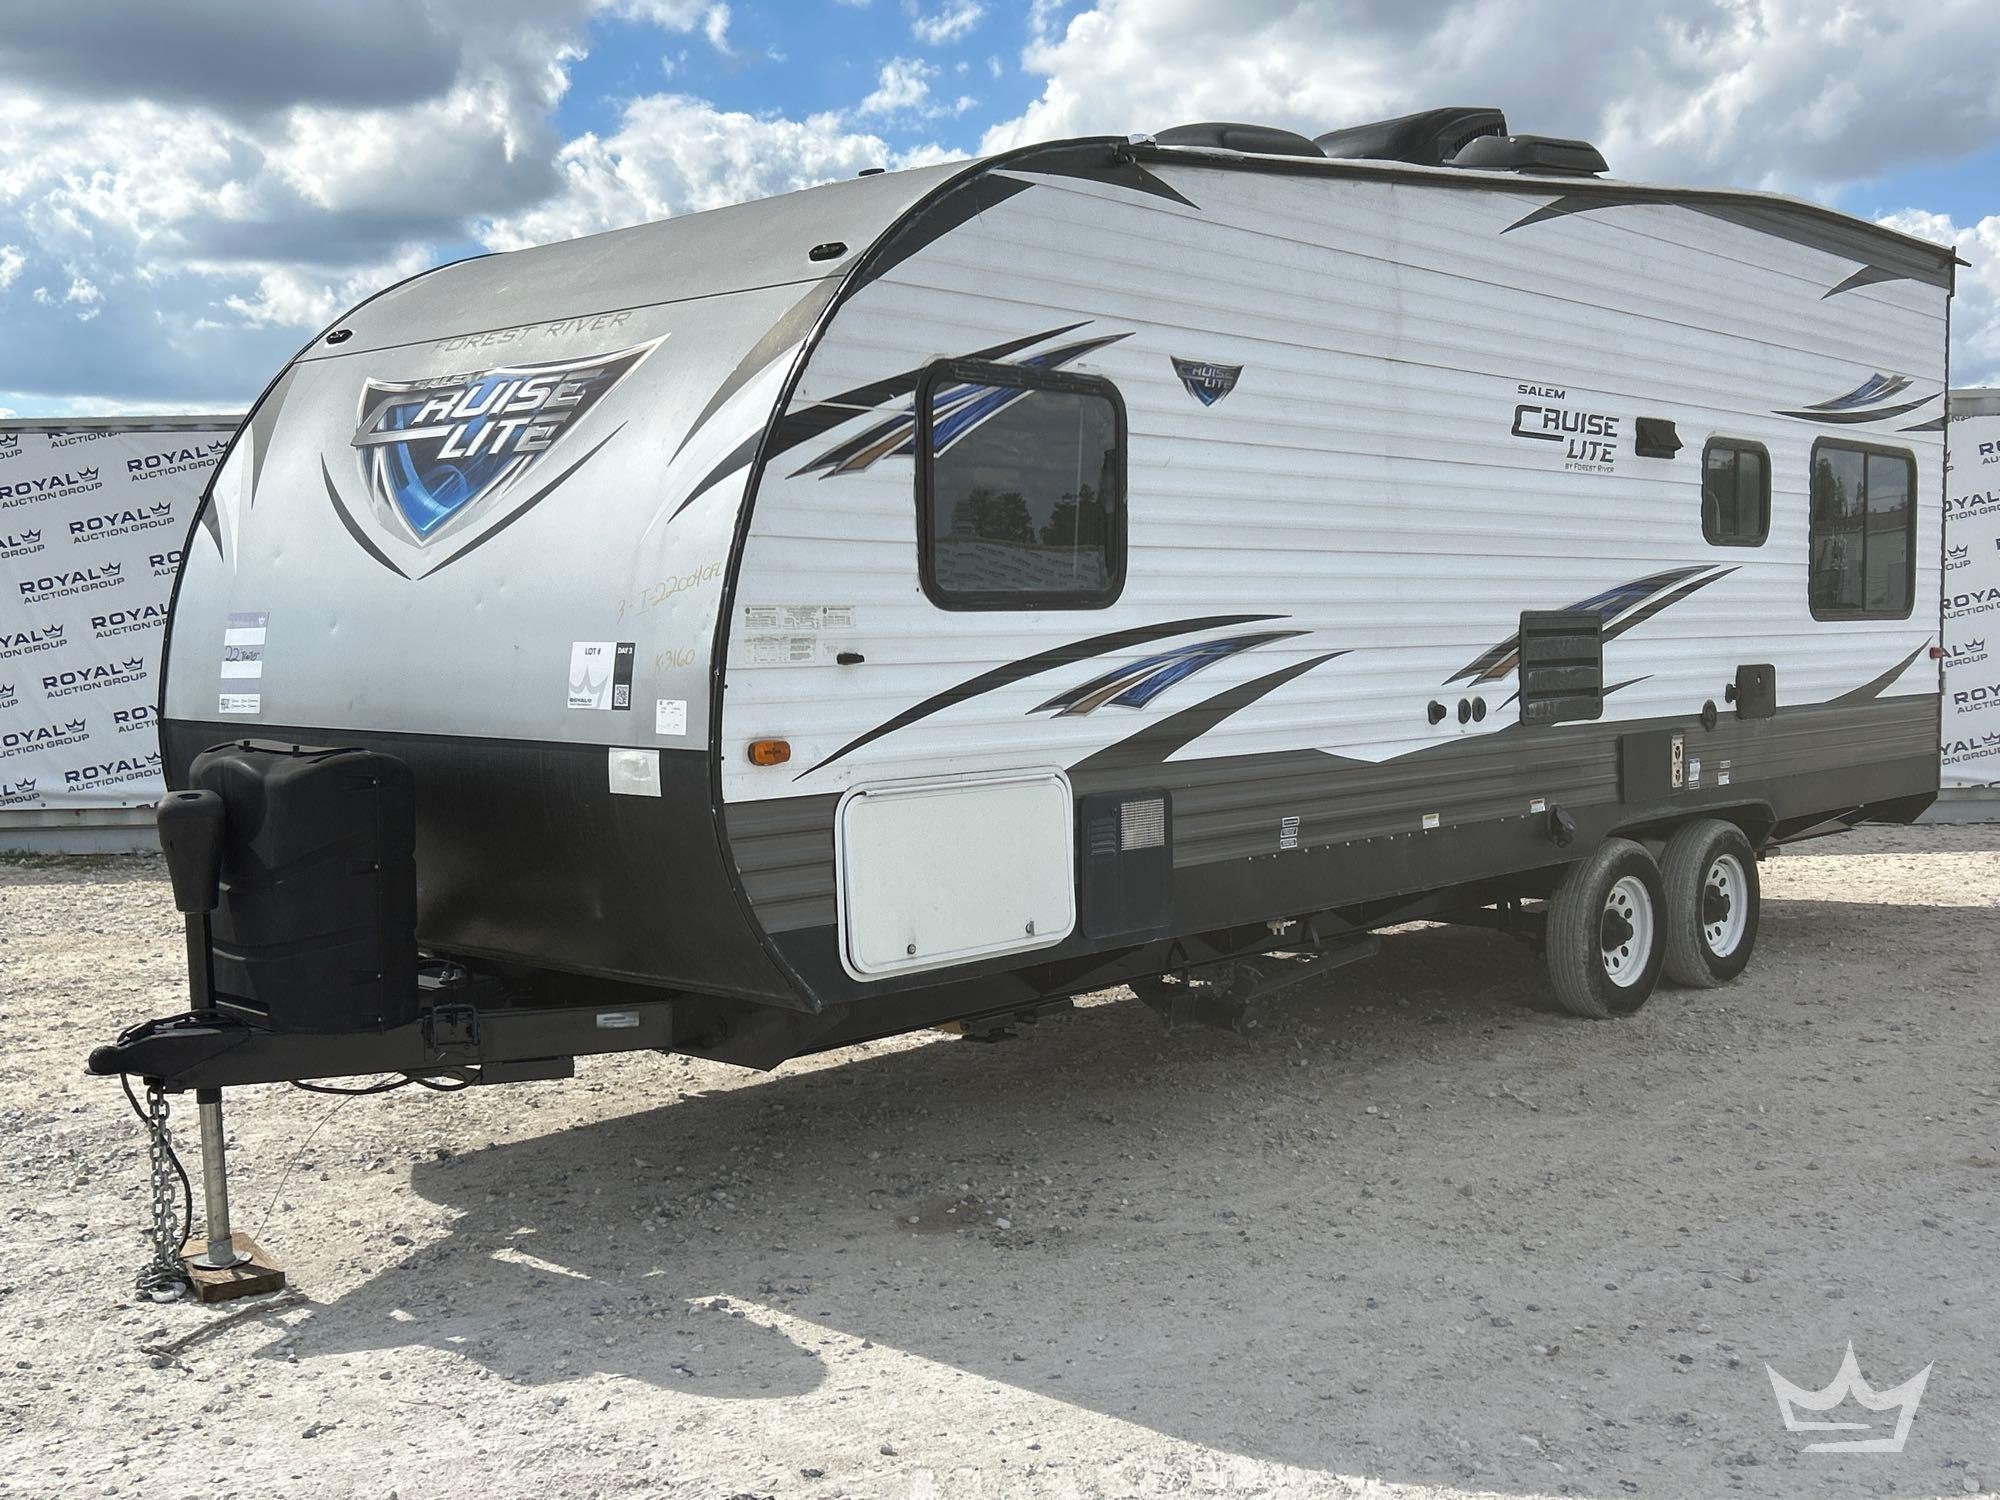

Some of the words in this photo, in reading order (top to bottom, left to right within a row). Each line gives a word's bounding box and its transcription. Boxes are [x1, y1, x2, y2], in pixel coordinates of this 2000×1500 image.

[430, 326, 538, 354] FOREST
[544, 311, 633, 337] RIVER
[1204, 378, 1234, 390] LITE
[1517, 384, 1566, 400] SALEM
[350, 369, 605, 448] CRUISE
[436, 410, 574, 461] LITE
[1511, 404, 1620, 442] CRUISE
[127, 446, 209, 473] ROYAL
[1566, 439, 1617, 463] LITE
[0, 473, 79, 500] ROYAL
[131, 465, 187, 482] AUCTION
[1, 491, 57, 509] AUCTION
[59, 482, 103, 497] GROUP
[69, 508, 151, 535] ROYAL
[73, 526, 129, 544] AUCTION
[131, 517, 175, 532] GROUP
[1, 544, 45, 559] GROUP
[20, 568, 101, 595] ROYAL
[23, 587, 79, 604] AUCTION
[81, 577, 125, 592] GROUP
[91, 604, 169, 630] ROYAL
[95, 621, 151, 639] AUCTION
[24, 639, 67, 654] GROUP
[585, 647, 597, 656] LOT
[1945, 653, 1989, 669] GROUP
[42, 663, 124, 690] ROYAL
[46, 681, 102, 699] AUCTION
[104, 672, 147, 687] GROUP
[46, 733, 90, 748] GROUP
[64, 757, 146, 784] ROYAL
[67, 775, 124, 793] AUCTION
